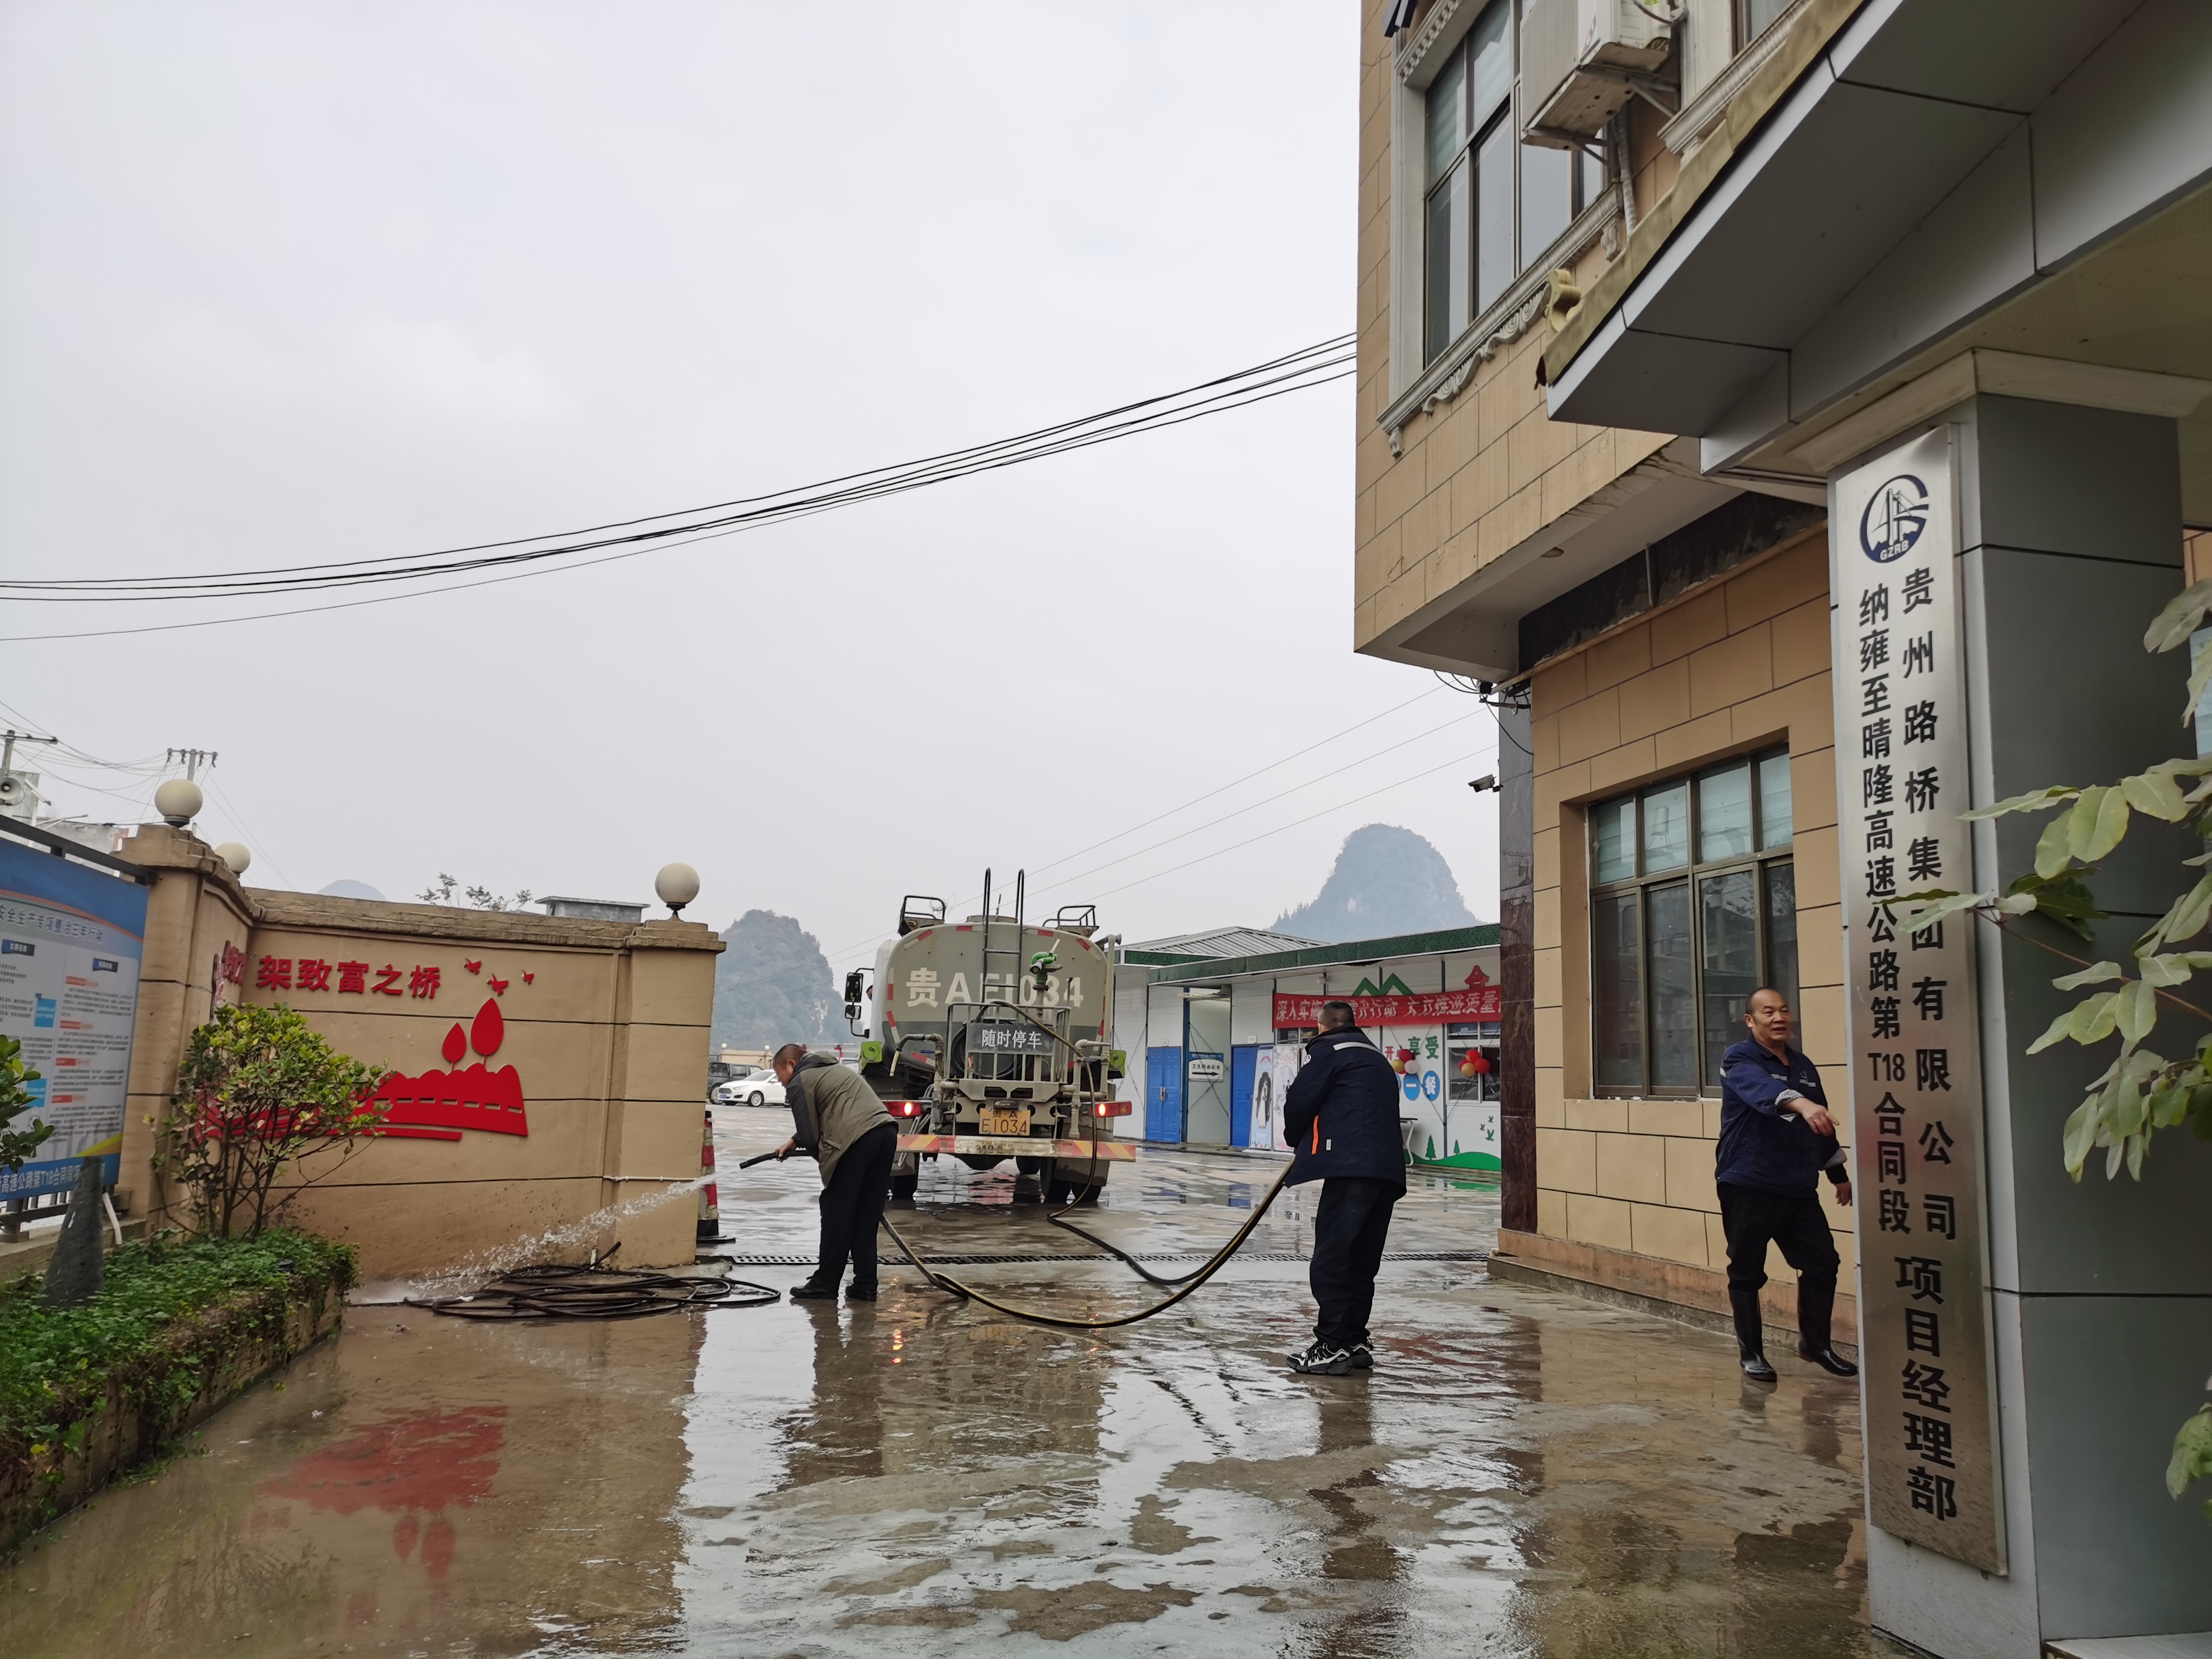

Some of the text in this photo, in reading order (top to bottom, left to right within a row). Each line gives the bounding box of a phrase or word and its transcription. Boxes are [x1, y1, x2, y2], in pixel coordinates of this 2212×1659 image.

[1879, 539, 1909, 561] GZRB
[1900, 566, 1956, 1238] 贵州路桥集团有限公司
[256, 955, 441, 999] 架致富之桥
[1276, 990, 1501, 1022] 深入实施提升行动 大力推进质量
[981, 1029, 1042, 1050] 随时停车
[1407, 1035, 1439, 1060] 享受
[981, 1118, 1027, 1134] E1034
[1894, 1255, 1957, 1522] 项目经理部
